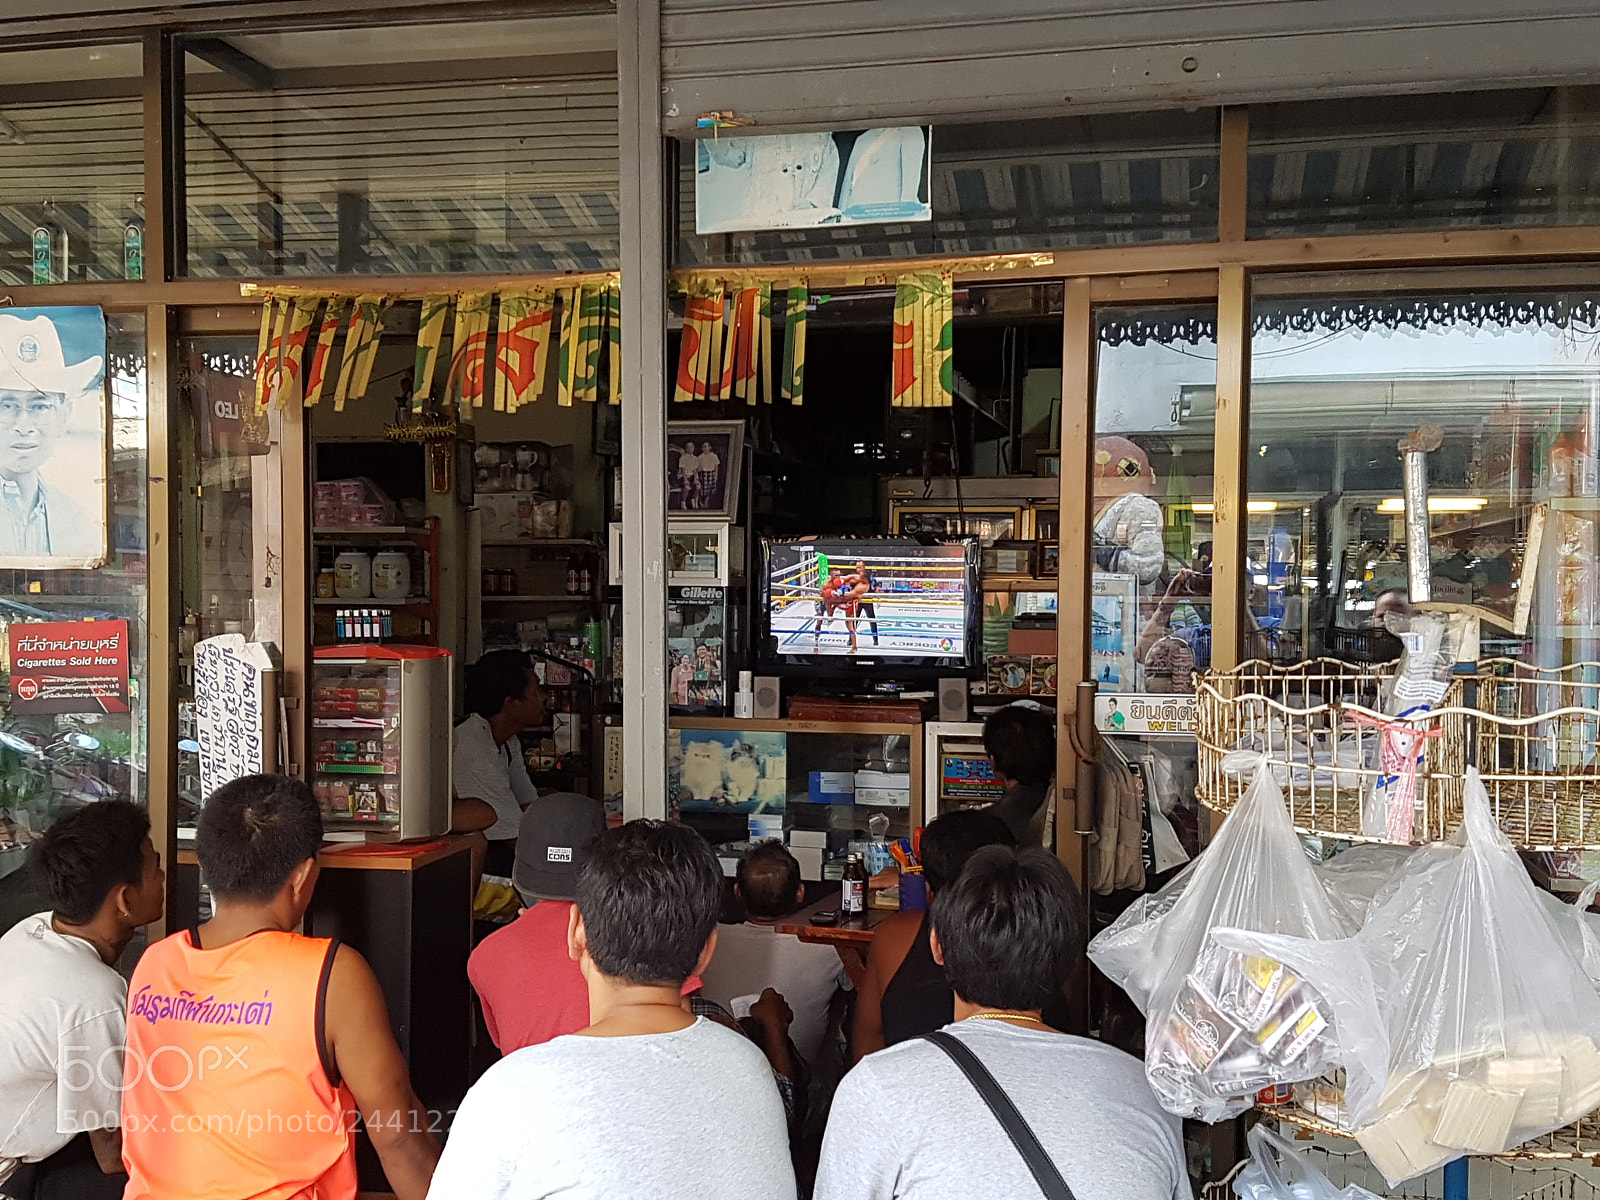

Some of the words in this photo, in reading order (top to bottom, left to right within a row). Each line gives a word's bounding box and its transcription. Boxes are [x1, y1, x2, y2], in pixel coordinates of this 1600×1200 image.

[681, 587, 723, 598] Gillette
[17, 632, 120, 653] ที่นี่จำหน่ายบุหรี่
[17, 658, 67, 668] Cigarettes
[69, 656, 92, 666] Sold
[94, 657, 118, 665] Here
[1148, 721, 1198, 731] WELC
